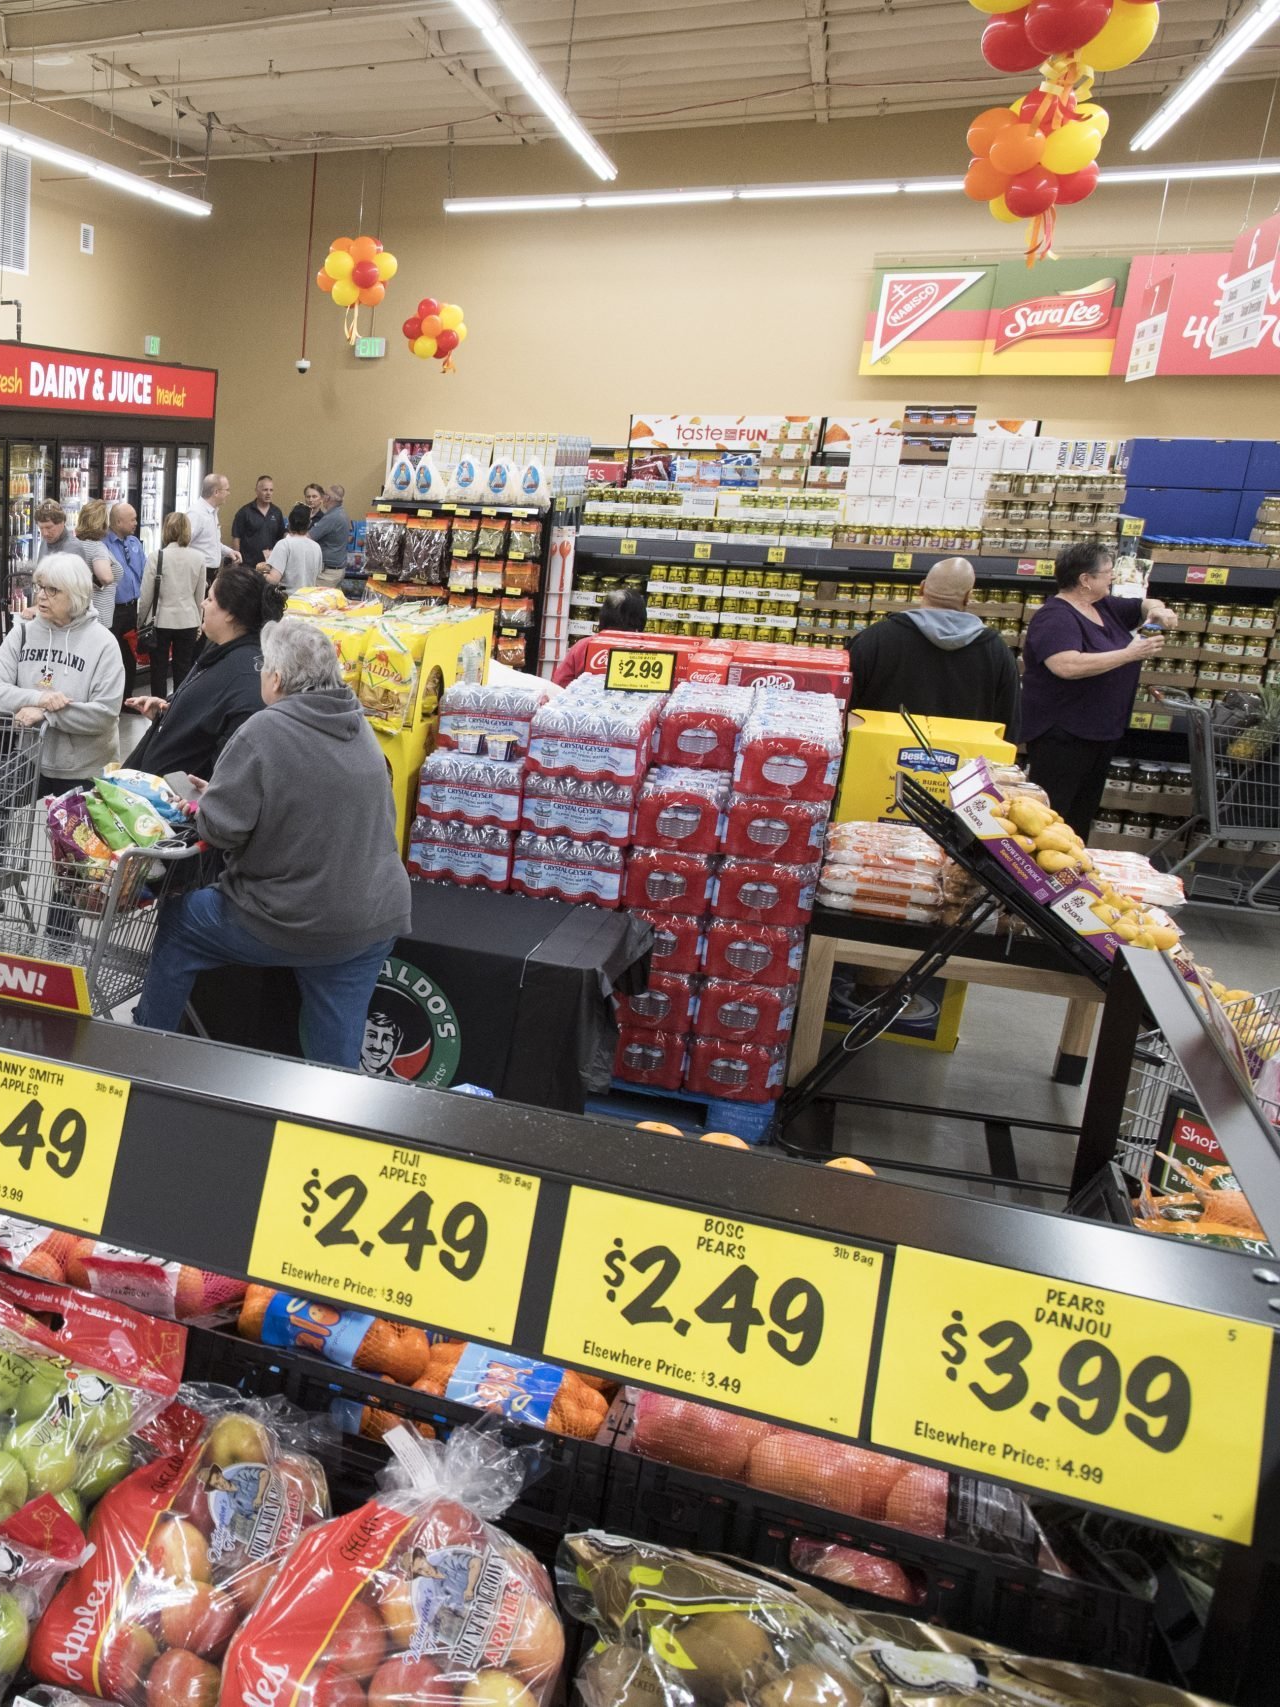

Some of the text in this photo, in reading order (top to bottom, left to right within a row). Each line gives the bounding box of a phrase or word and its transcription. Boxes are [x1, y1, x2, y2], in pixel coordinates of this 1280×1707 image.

[890, 286, 935, 323] NABISCO
[1005, 300, 1101, 338] Sara Lee
[30, 361, 90, 400] DAIRY
[92, 368, 104, 400] &
[109, 371, 152, 404] JUICE
[156, 385, 186, 408] market
[676, 424, 722, 441] taste
[739, 429, 768, 441] FUN
[19, 648, 86, 673] DISNEYLAND
[618, 659, 663, 679] $2.99
[560, 742, 610, 753] CRYSTAL GEYSER
[901, 752, 925, 761] Best
[553, 802, 602, 815] CRYSTAL GEYSER
[544, 864, 592, 877] CRYSTAL GEYSER
[0, 1078, 39, 1097] APPLES
[28, 1068, 64, 1086] SMITH
[95, 1082, 123, 1097] 3lb Bag
[1180, 1126, 1220, 1153] Shop
[392, 1150, 421, 1168] FUJI
[379, 1166, 427, 1188] APPLES
[496, 1172, 532, 1191] 3lb Bag
[301, 1167, 488, 1282] $2.49
[703, 1218, 745, 1240] BOSC
[696, 1236, 746, 1260] PEARS
[833, 1246, 874, 1267] 3lb Bag
[281, 1262, 413, 1308] Elsewhere Price: $3.99
[603, 1237, 825, 1367] $2.49
[1046, 1288, 1106, 1316] PEARS
[1034, 1307, 1112, 1339] DANJOU
[1227, 1329, 1237, 1342] 5
[582, 1340, 742, 1394] Elsewhere Price: $3.49
[940, 1310, 1192, 1454] $3.99
[913, 1420, 1104, 1484] Elsewhere Price: $4.99
[339, 1515, 379, 1561] CHELAN
[50, 1575, 116, 1681] Apples
[484, 1578, 524, 1667] APPLES
